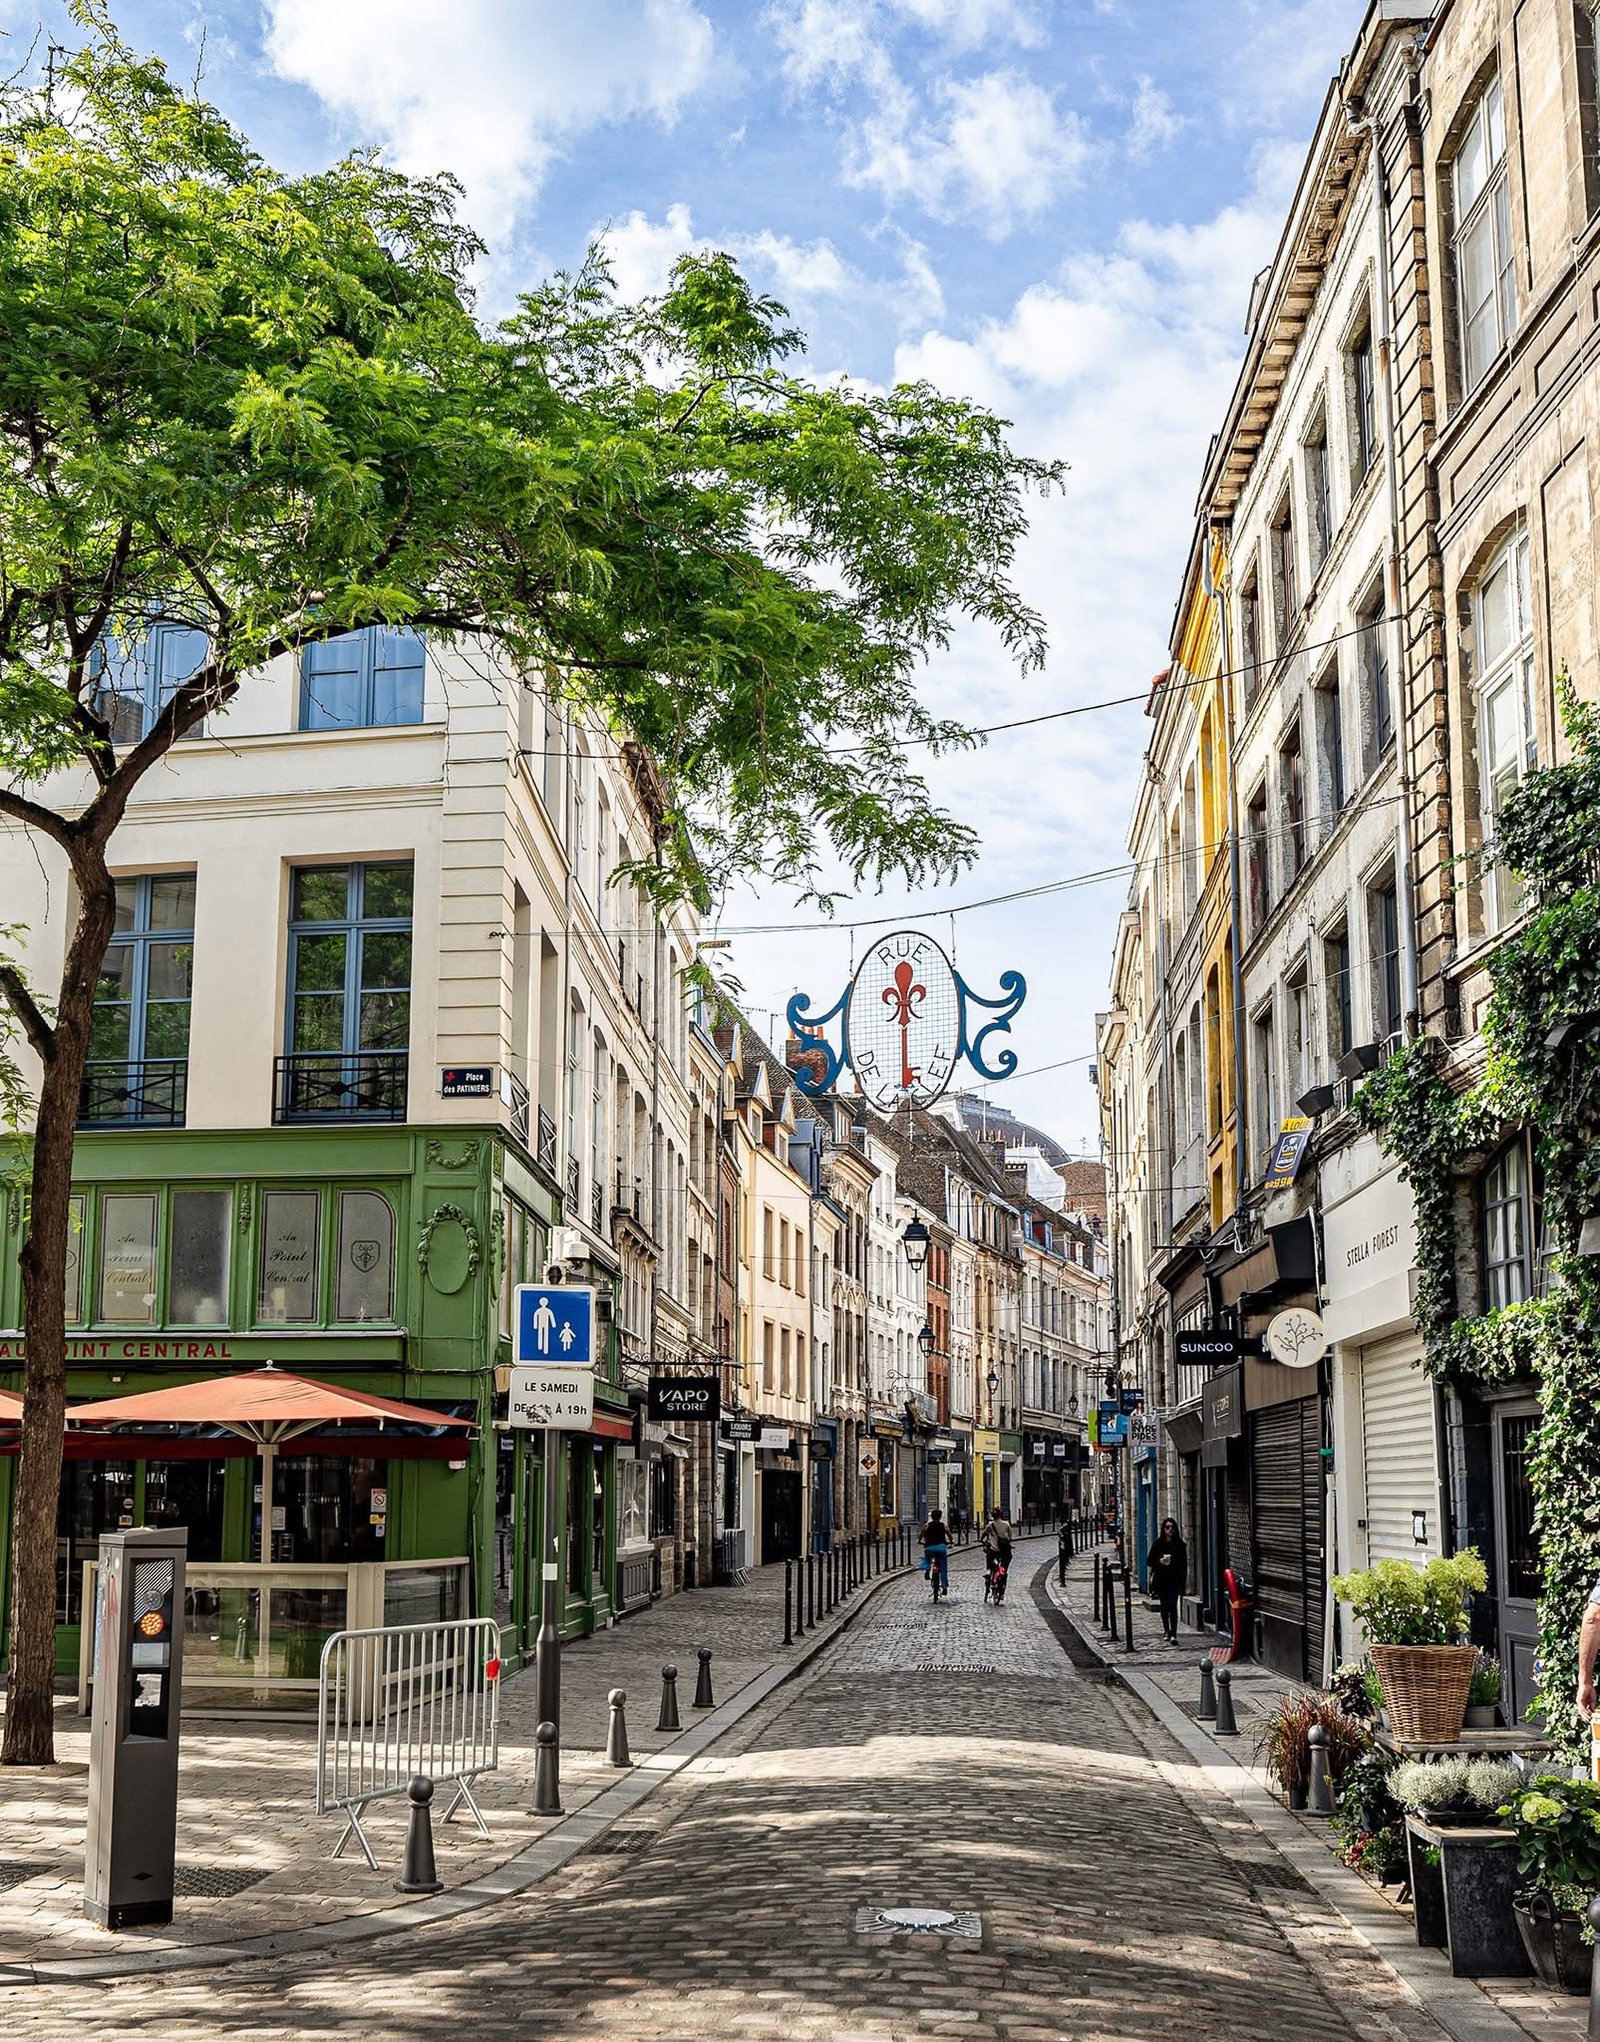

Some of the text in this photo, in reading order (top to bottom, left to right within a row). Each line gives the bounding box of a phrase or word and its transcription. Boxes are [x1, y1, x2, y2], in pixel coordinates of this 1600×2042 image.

[877, 939, 931, 966] RUE
[465, 1072, 484, 1081] Place
[856, 1044, 951, 1108] DE LA CLEF
[443, 1085, 455, 1093] des
[279, 1232, 297, 1241] Au
[1347, 1225, 1398, 1267] STELLA FOREST
[270, 1250, 307, 1261] Point
[106, 1271, 148, 1283] Central
[0, 1343, 232, 1358] AU INT CENTRAL
[1180, 1343, 1233, 1353] SUNCOO
[525, 1382, 578, 1393] LE SAMEDI
[659, 1389, 709, 1402] VAPO
[514, 1403, 527, 1412] DE
[555, 1402, 562, 1414] À
[567, 1405, 587, 1415] 19h
[667, 1402, 707, 1411] STORE
